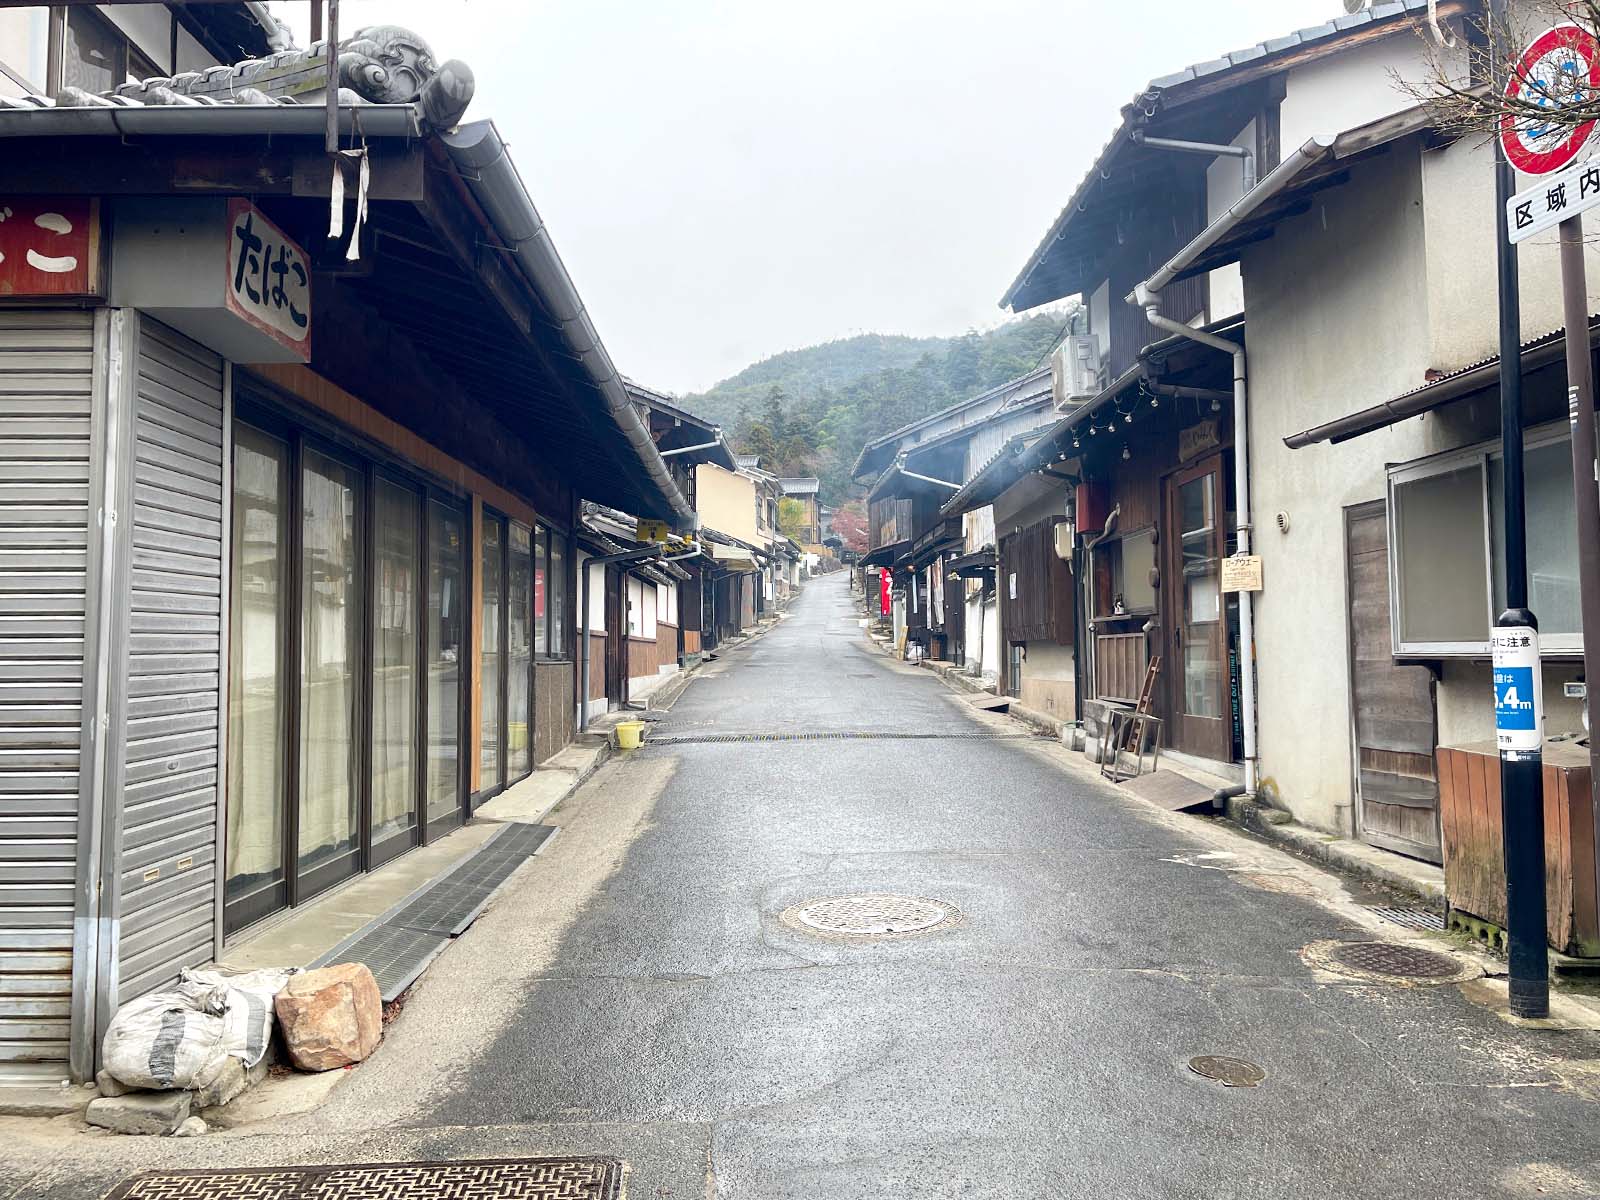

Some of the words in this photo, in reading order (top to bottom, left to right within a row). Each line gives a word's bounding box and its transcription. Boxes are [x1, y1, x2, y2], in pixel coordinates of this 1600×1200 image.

[1515, 167, 1600, 229] 区域内
[0, 206, 77, 273] こ
[235, 211, 307, 328] たばこ
